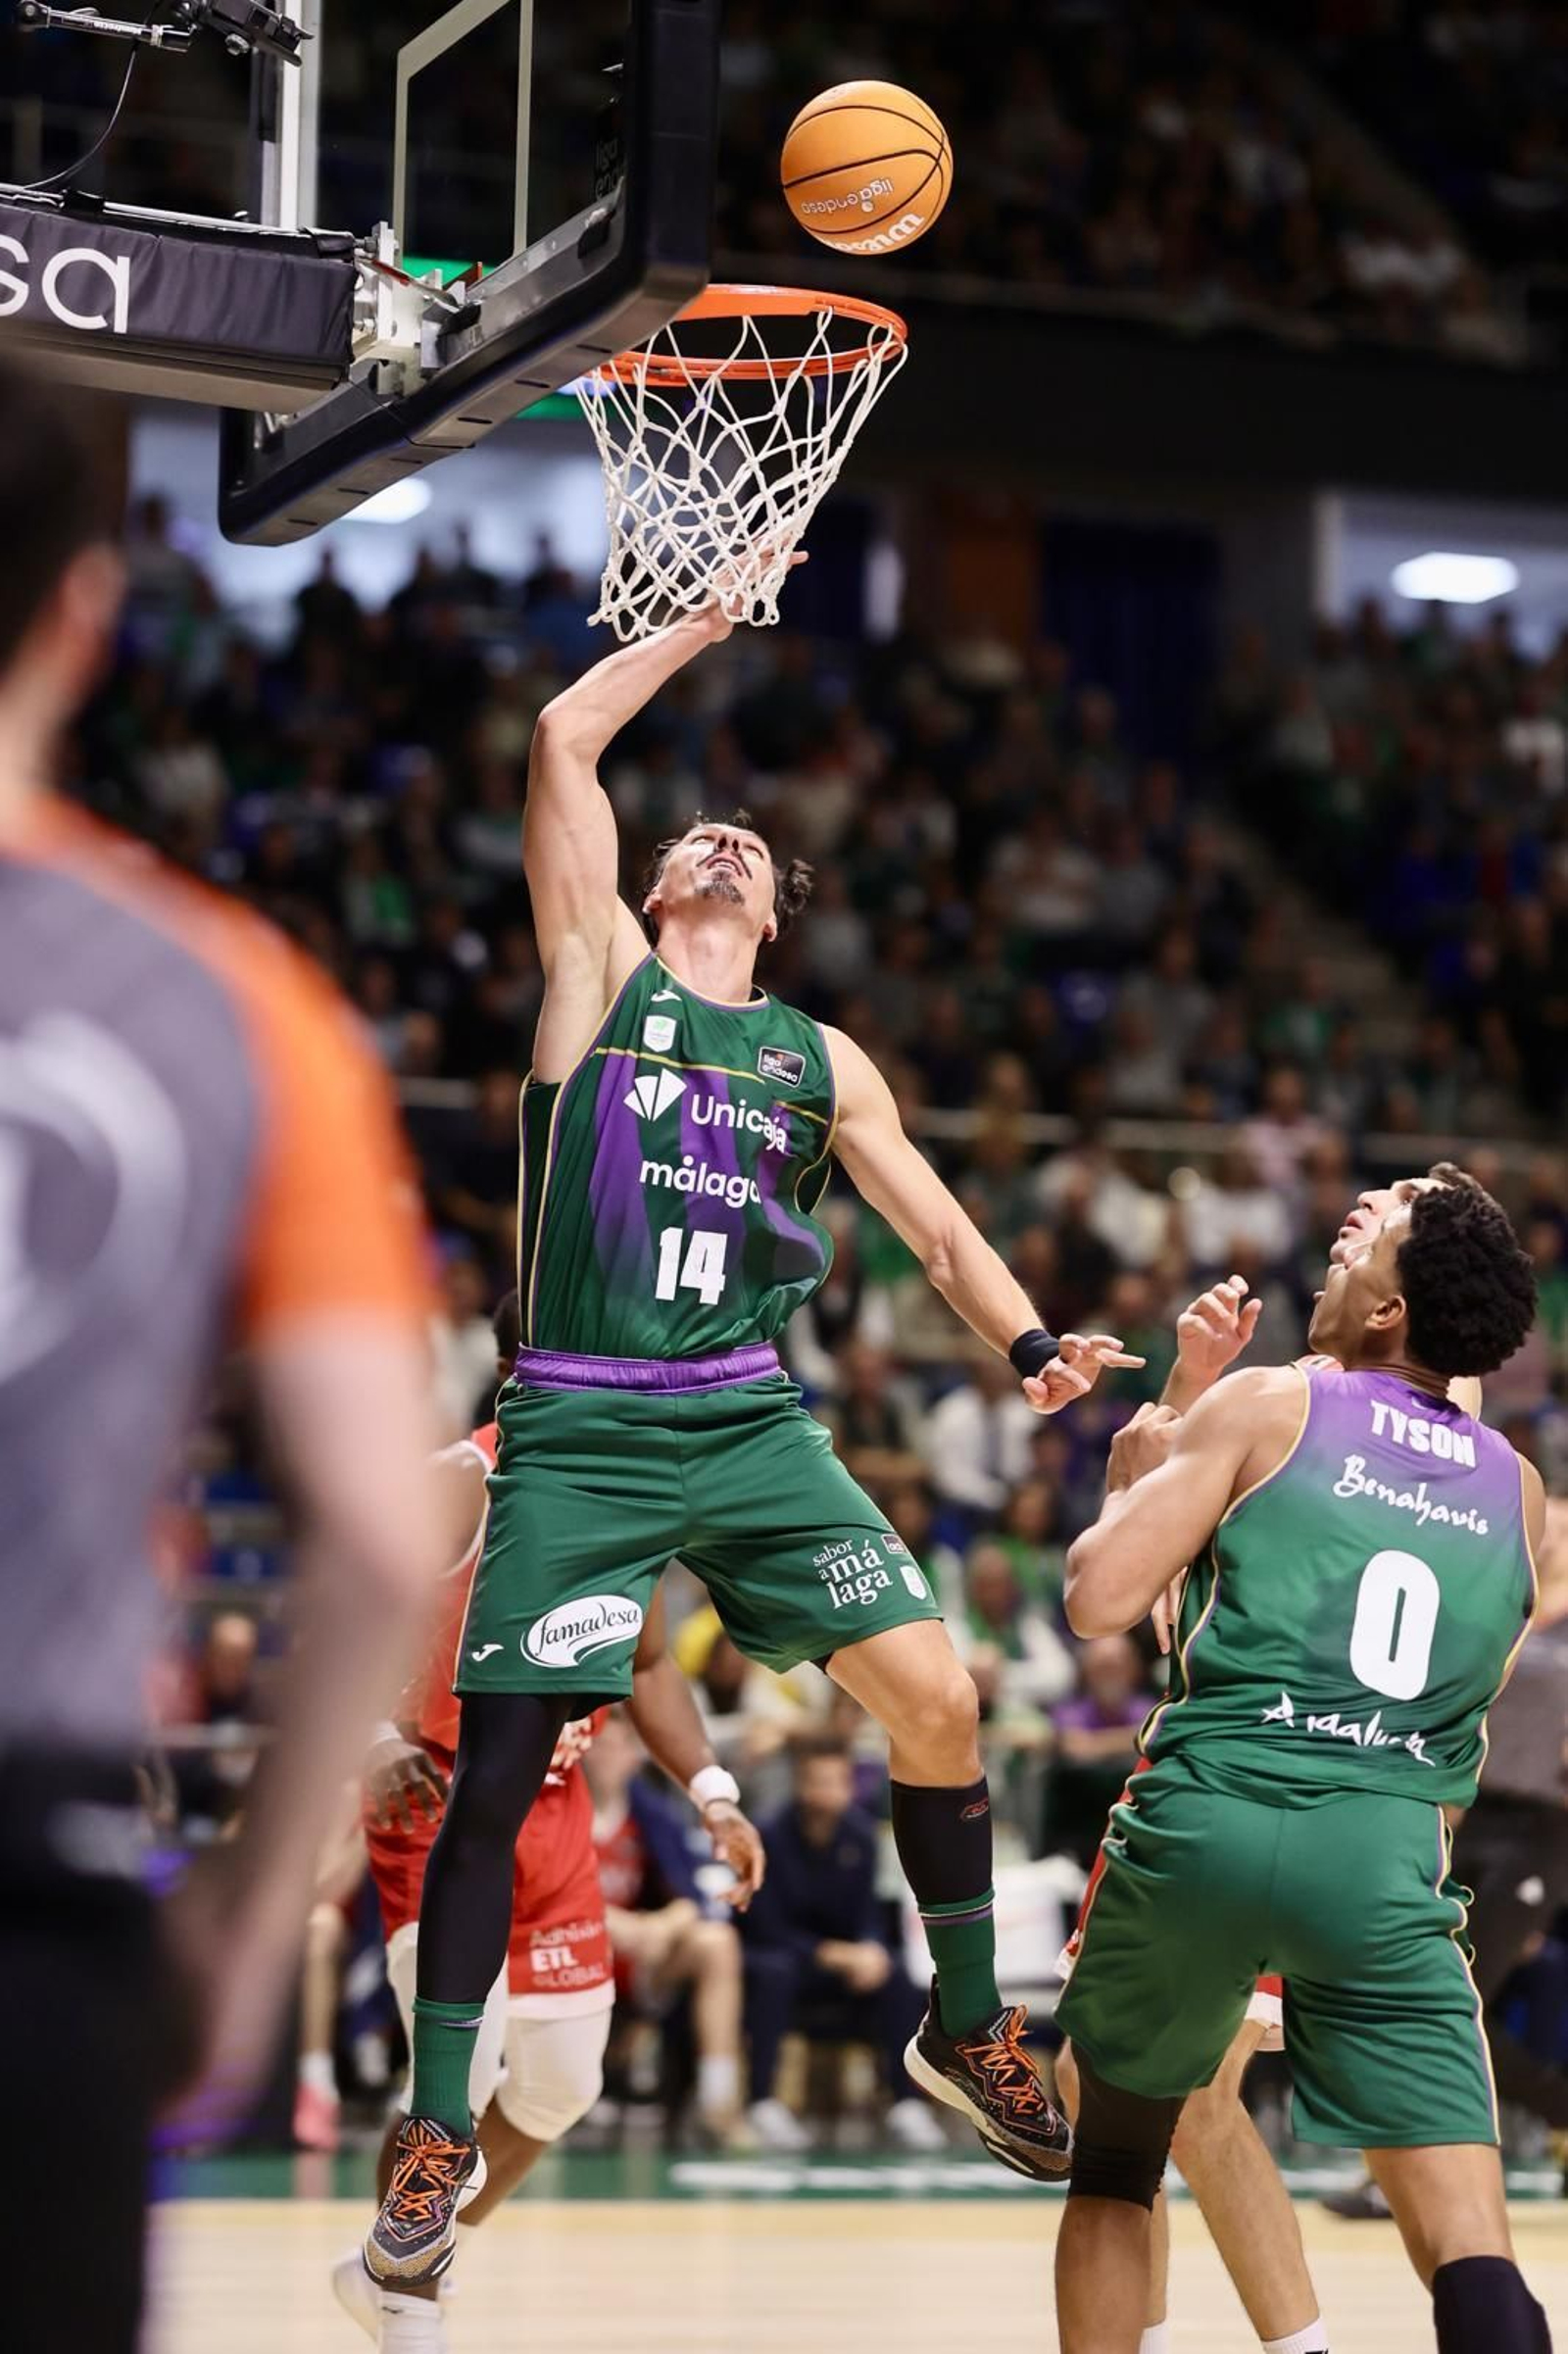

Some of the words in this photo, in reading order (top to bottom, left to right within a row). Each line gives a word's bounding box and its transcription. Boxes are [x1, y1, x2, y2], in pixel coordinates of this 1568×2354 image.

[859, 177, 894, 198] liga
[691, 1094, 788, 1153] Unicaja
[655, 1226, 728, 1305] 14
[1370, 1399, 1476, 1468] TYSON
[812, 1539, 854, 1567] sabor
[818, 1568, 830, 1580] a
[827, 1539, 885, 1584] má
[826, 1569, 894, 1609] laga
[535, 1602, 639, 1656] famadesa
[1349, 1548, 1441, 1701] 0
[531, 1945, 580, 1973] ETL
